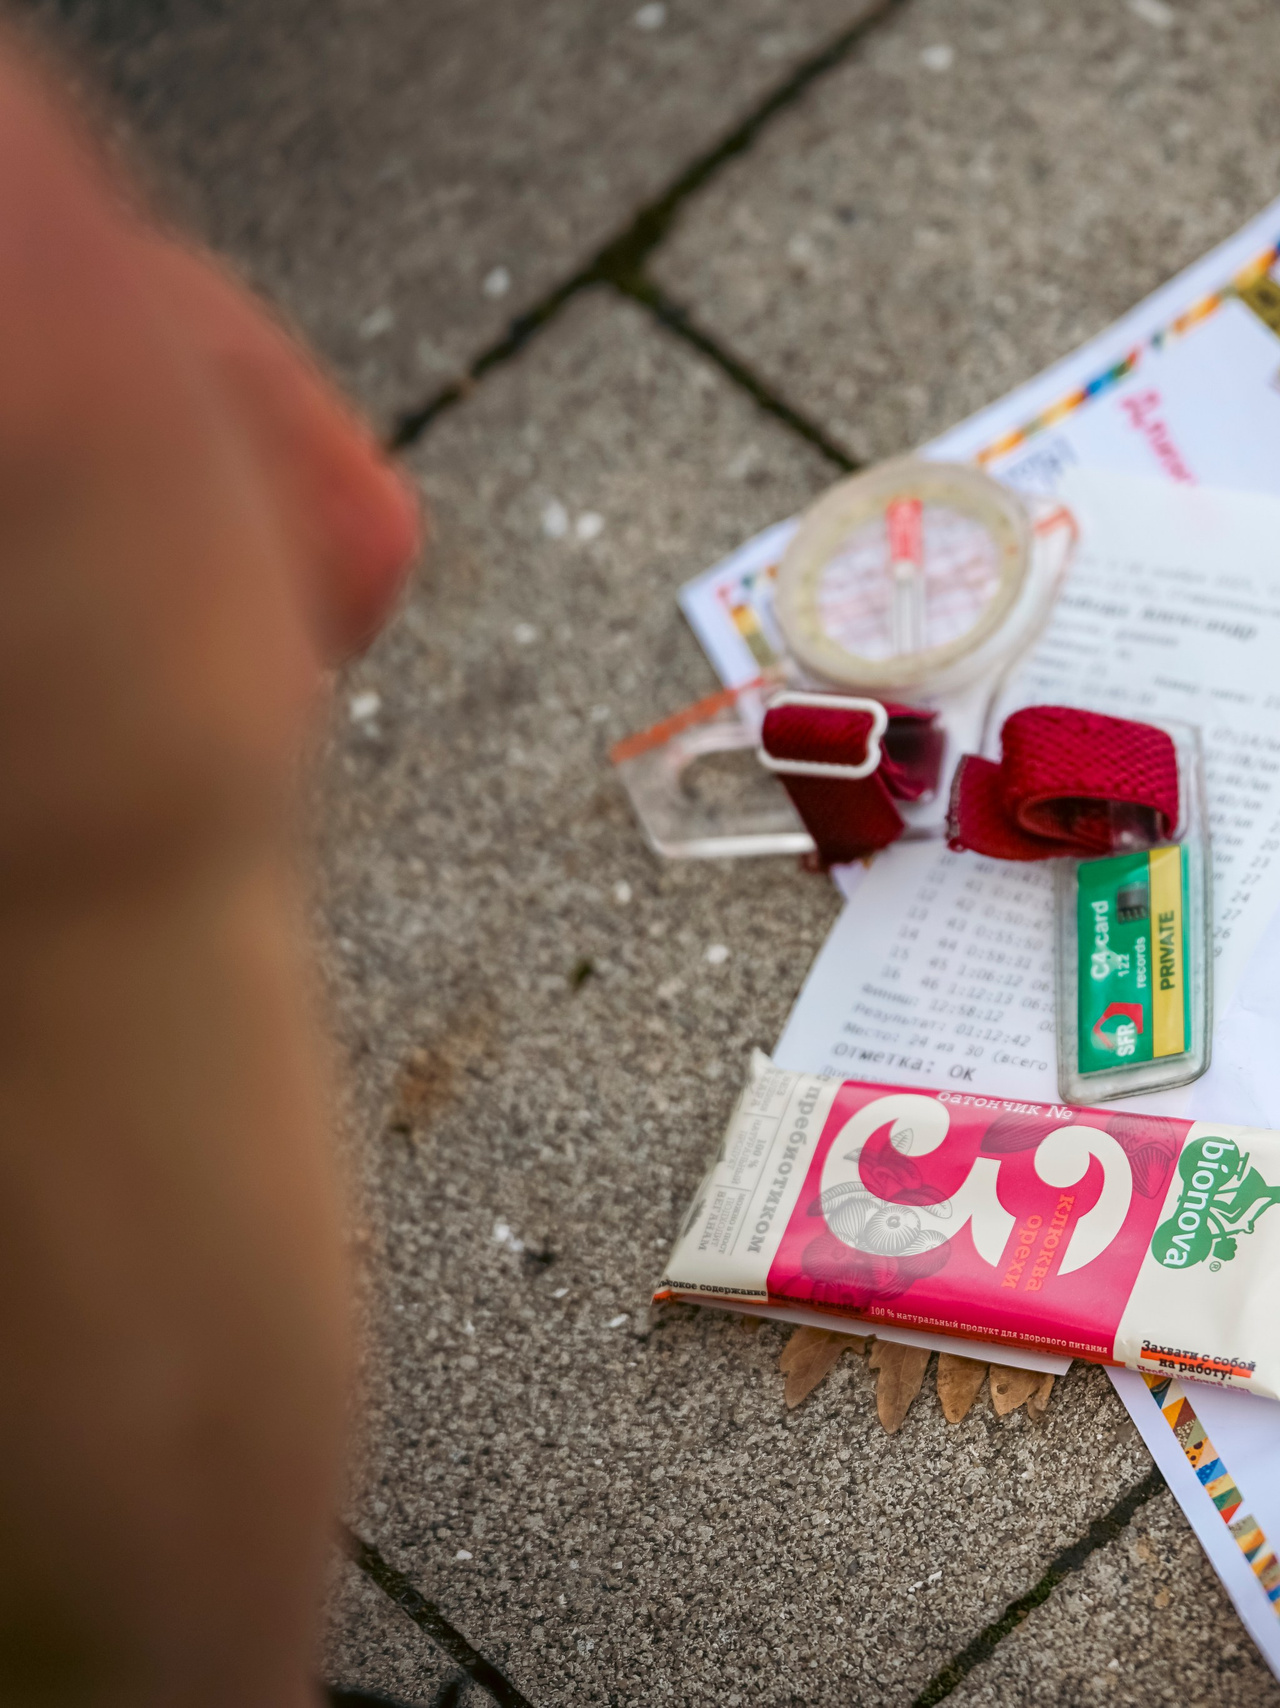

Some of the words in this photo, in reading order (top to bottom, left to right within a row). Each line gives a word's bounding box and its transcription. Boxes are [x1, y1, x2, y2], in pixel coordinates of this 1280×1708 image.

[1117, 952, 1130, 977] 122
[1133, 936, 1146, 989] records
[1158, 909, 1176, 991] PRIVATE
[929, 1000, 1004, 1024] 12:58:12
[908, 1033, 930, 1048] 24
[934, 1040, 955, 1053] из
[964, 1045, 984, 1059] 30
[991, 1048, 1048, 1072] (всего
[955, 1022, 1031, 1048] 01:12:42
[1116, 1021, 1136, 1058] SFR
[833, 1041, 936, 1075] Отметка:
[937, 1090, 1043, 1116] батончик
[747, 1085, 822, 1253] пребиотиком
[1163, 1141, 1235, 1266] bionova
[1002, 1214, 1043, 1291] орехи
[1028, 1193, 1075, 1293] клюква
[699, 1283, 767, 1298] содержание
[870, 1306, 885, 1317] 100
[886, 1308, 895, 1318] %
[896, 1311, 959, 1329] натуральный
[960, 1322, 1000, 1337] продукт
[1000, 1328, 1018, 1340] для
[1019, 1331, 1067, 1348] здорового
[1068, 1340, 1109, 1354] питания
[1141, 1339, 1200, 1361] Захвати
[1201, 1353, 1211, 1363] с
[1213, 1355, 1257, 1372] собой
[1159, 1357, 1176, 1370] на
[1179, 1361, 1234, 1380] работу!
